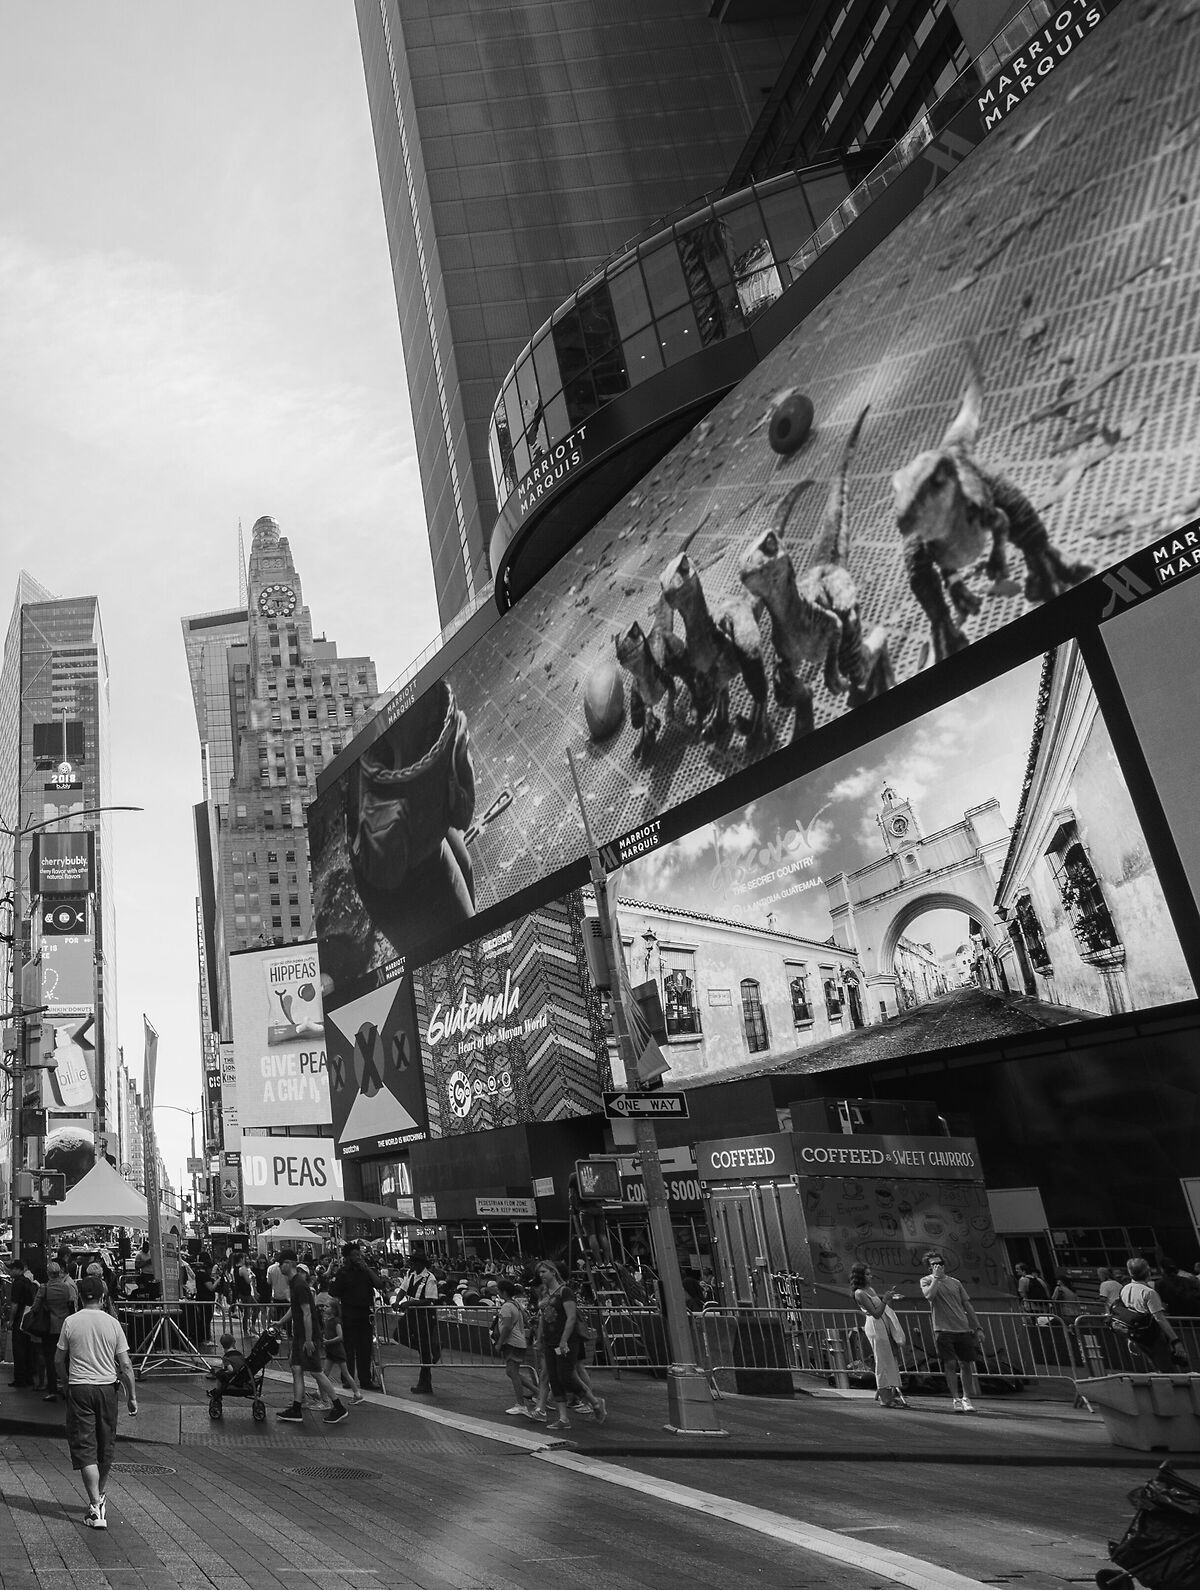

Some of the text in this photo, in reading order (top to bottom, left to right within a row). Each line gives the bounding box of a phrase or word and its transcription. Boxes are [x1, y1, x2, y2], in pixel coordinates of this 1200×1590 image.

[985, 8, 1100, 130] MARQUIS
[517, 426, 587, 499] MARRIOTT
[520, 451, 580, 515] MARQUIS
[387, 680, 417, 714] MARRIOTT
[388, 695, 415, 725] MARQUIS
[52, 774, 76, 783] 2018
[619, 820, 661, 850] MARRIOTT
[621, 835, 659, 861] MARQUIS
[747, 871, 776, 890] SECRET
[776, 855, 814, 878] COUNTRY
[781, 876, 824, 898] GUATEMALA
[270, 962, 317, 983] HIPPEAS
[385, 956, 406, 972] MARRIOTT
[386, 966, 405, 980] MARQUIS
[427, 969, 520, 1045] Guatemala
[458, 1014, 547, 1055] Heart of the Mayan World
[58, 1060, 88, 1087] billie
[260, 1053, 297, 1078] GIVE
[264, 1081, 275, 1103] A
[616, 1099, 676, 1111] ONE WAY
[378, 1139, 386, 1148] THE
[385, 1137, 398, 1147] WORLD
[403, 1133, 423, 1143] WATCHING
[711, 1147, 775, 1168] COFFEED
[801, 1147, 975, 1167] COFFEED & SWEET CHURROS
[273, 1156, 327, 1187] PEAS
[671, 1180, 703, 1201] SOON
